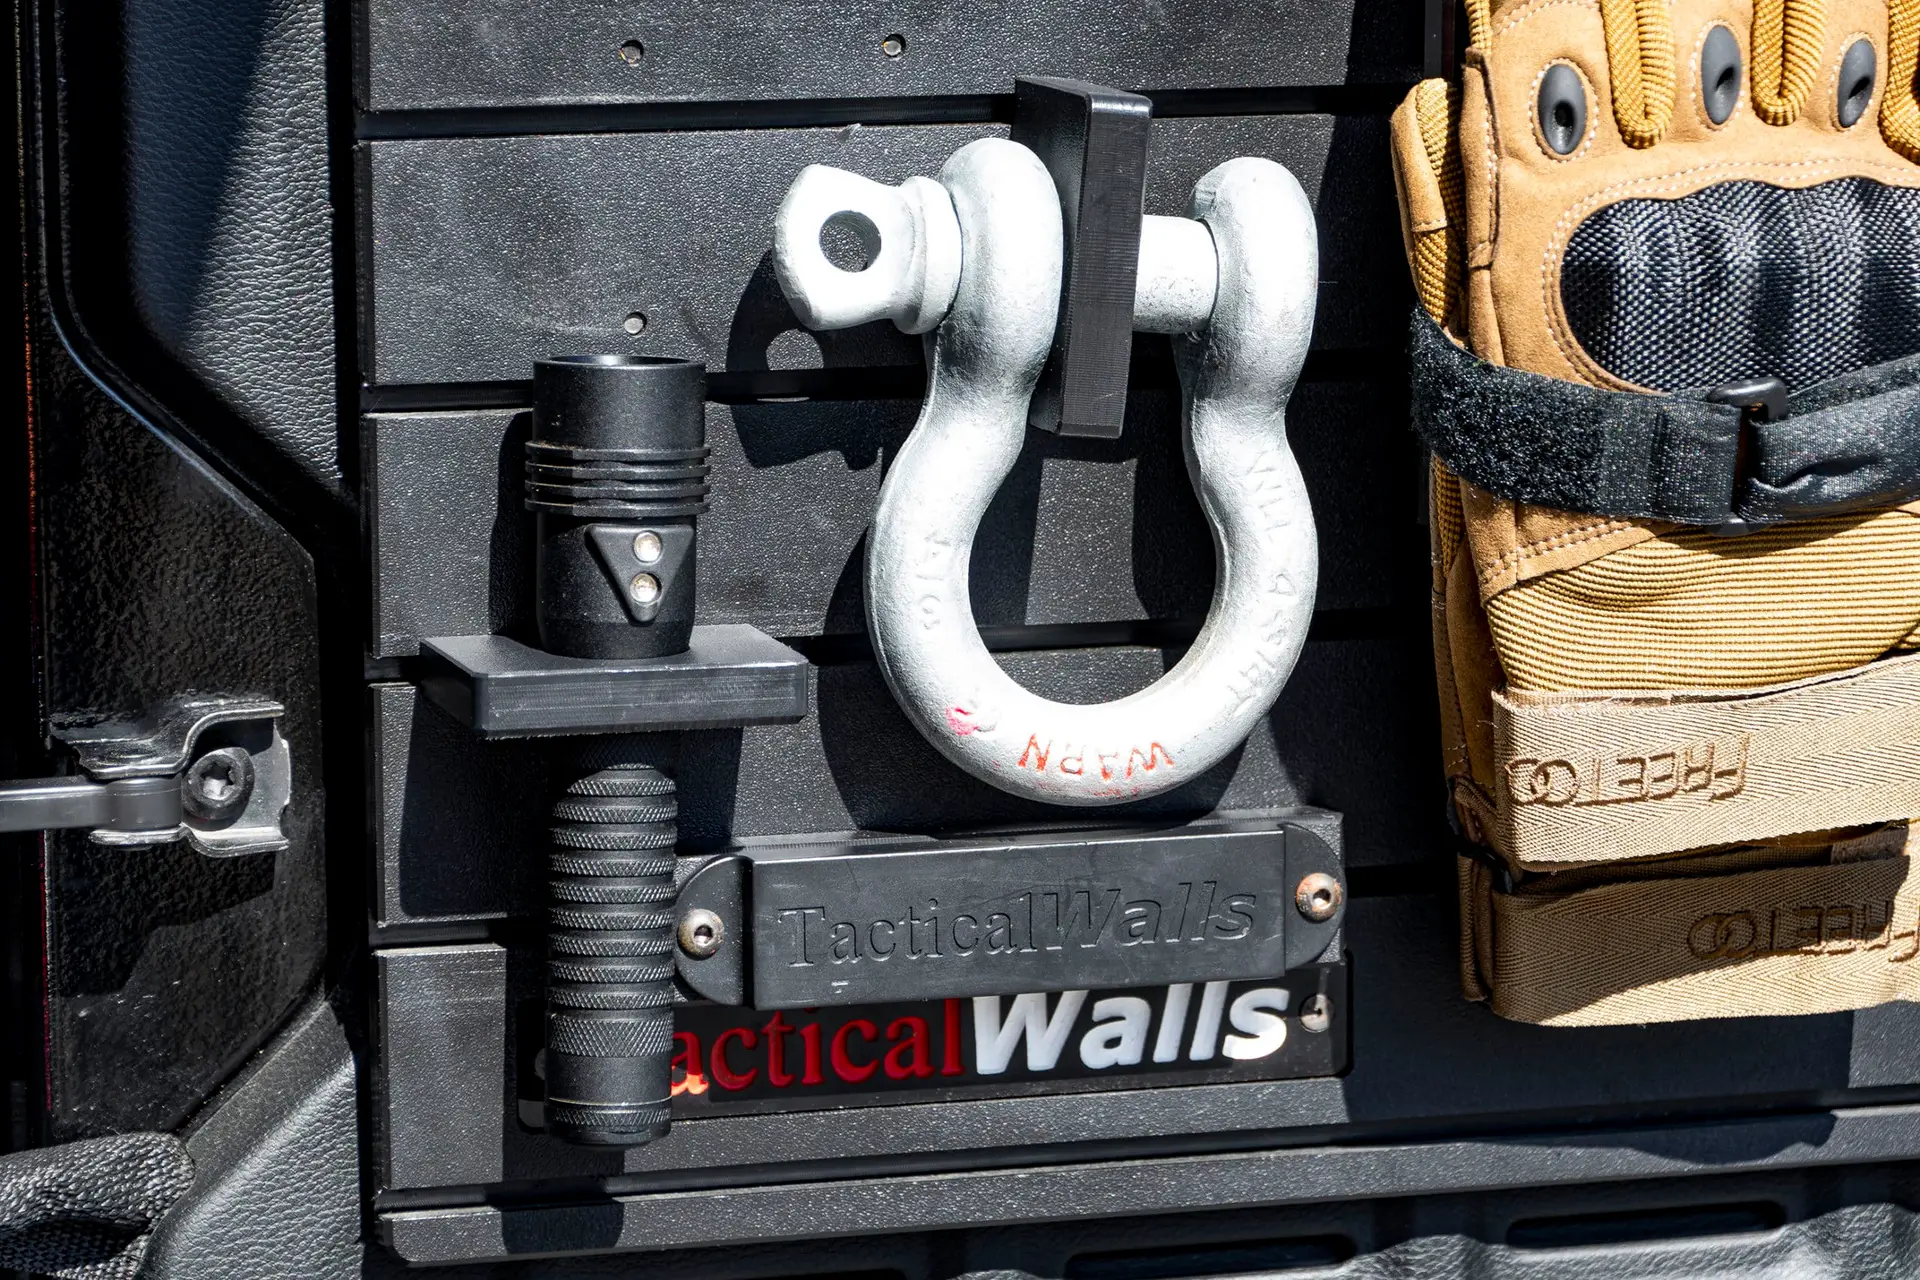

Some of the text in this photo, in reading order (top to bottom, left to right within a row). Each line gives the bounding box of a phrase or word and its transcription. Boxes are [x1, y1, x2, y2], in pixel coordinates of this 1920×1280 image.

[1017, 733, 1175, 780] WARN
[1505, 732, 1750, 808] FREETOO
[778, 878, 1257, 968] TacticalWalls
[671, 979, 1290, 1097] acticalWalls
